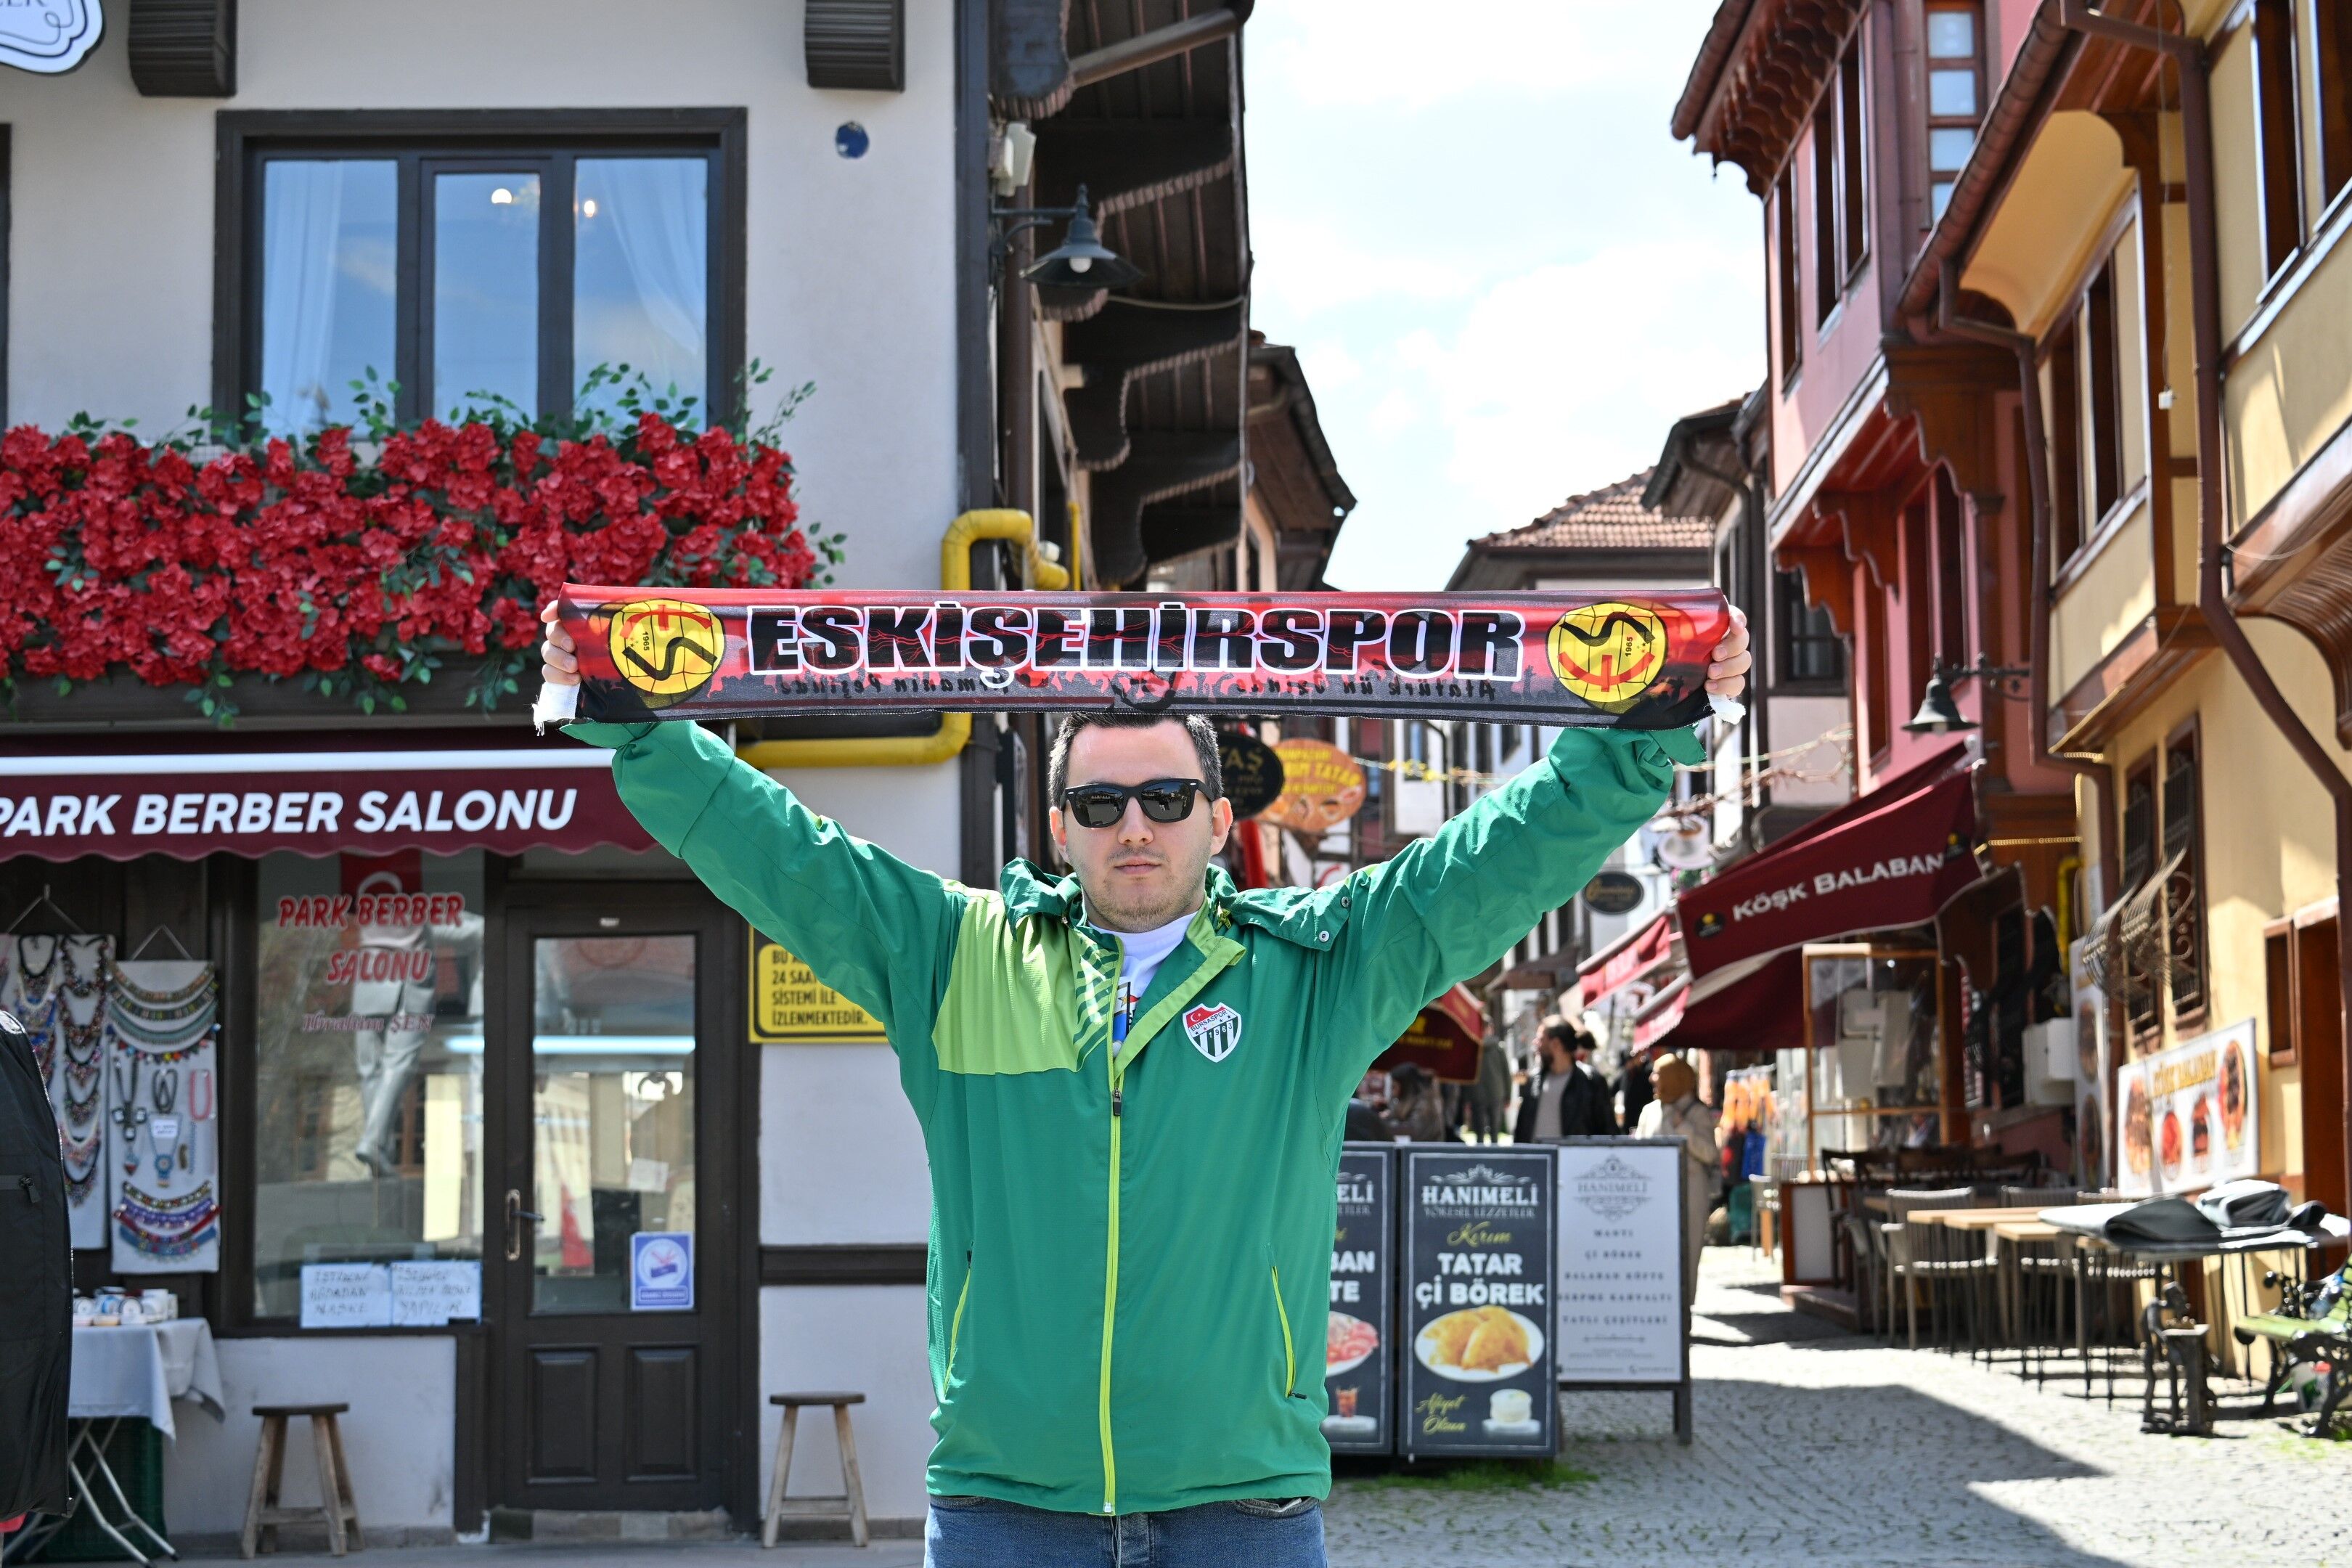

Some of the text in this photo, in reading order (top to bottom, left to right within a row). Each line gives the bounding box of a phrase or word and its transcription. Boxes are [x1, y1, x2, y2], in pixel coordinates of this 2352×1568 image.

[747, 600, 1525, 689] ESKİŞEHİRSPOR
[131, 792, 343, 835] BERBER
[354, 788, 578, 833] SALONU
[1732, 852, 1945, 922] KÖŞK BALABAN
[278, 891, 465, 928] PARK BERBER
[326, 949, 433, 984] SALONU
[772, 970, 786, 984] 24
[772, 988, 817, 1006] SİSTEMİ
[1191, 1010, 1228, 1032] BURSASPOR
[1208, 1022, 1233, 1039] 1963
[1421, 1183, 1539, 1206] HANIMELİ
[1437, 1252, 1523, 1275] TATAR
[1449, 1277, 1545, 1306] BÖREK
